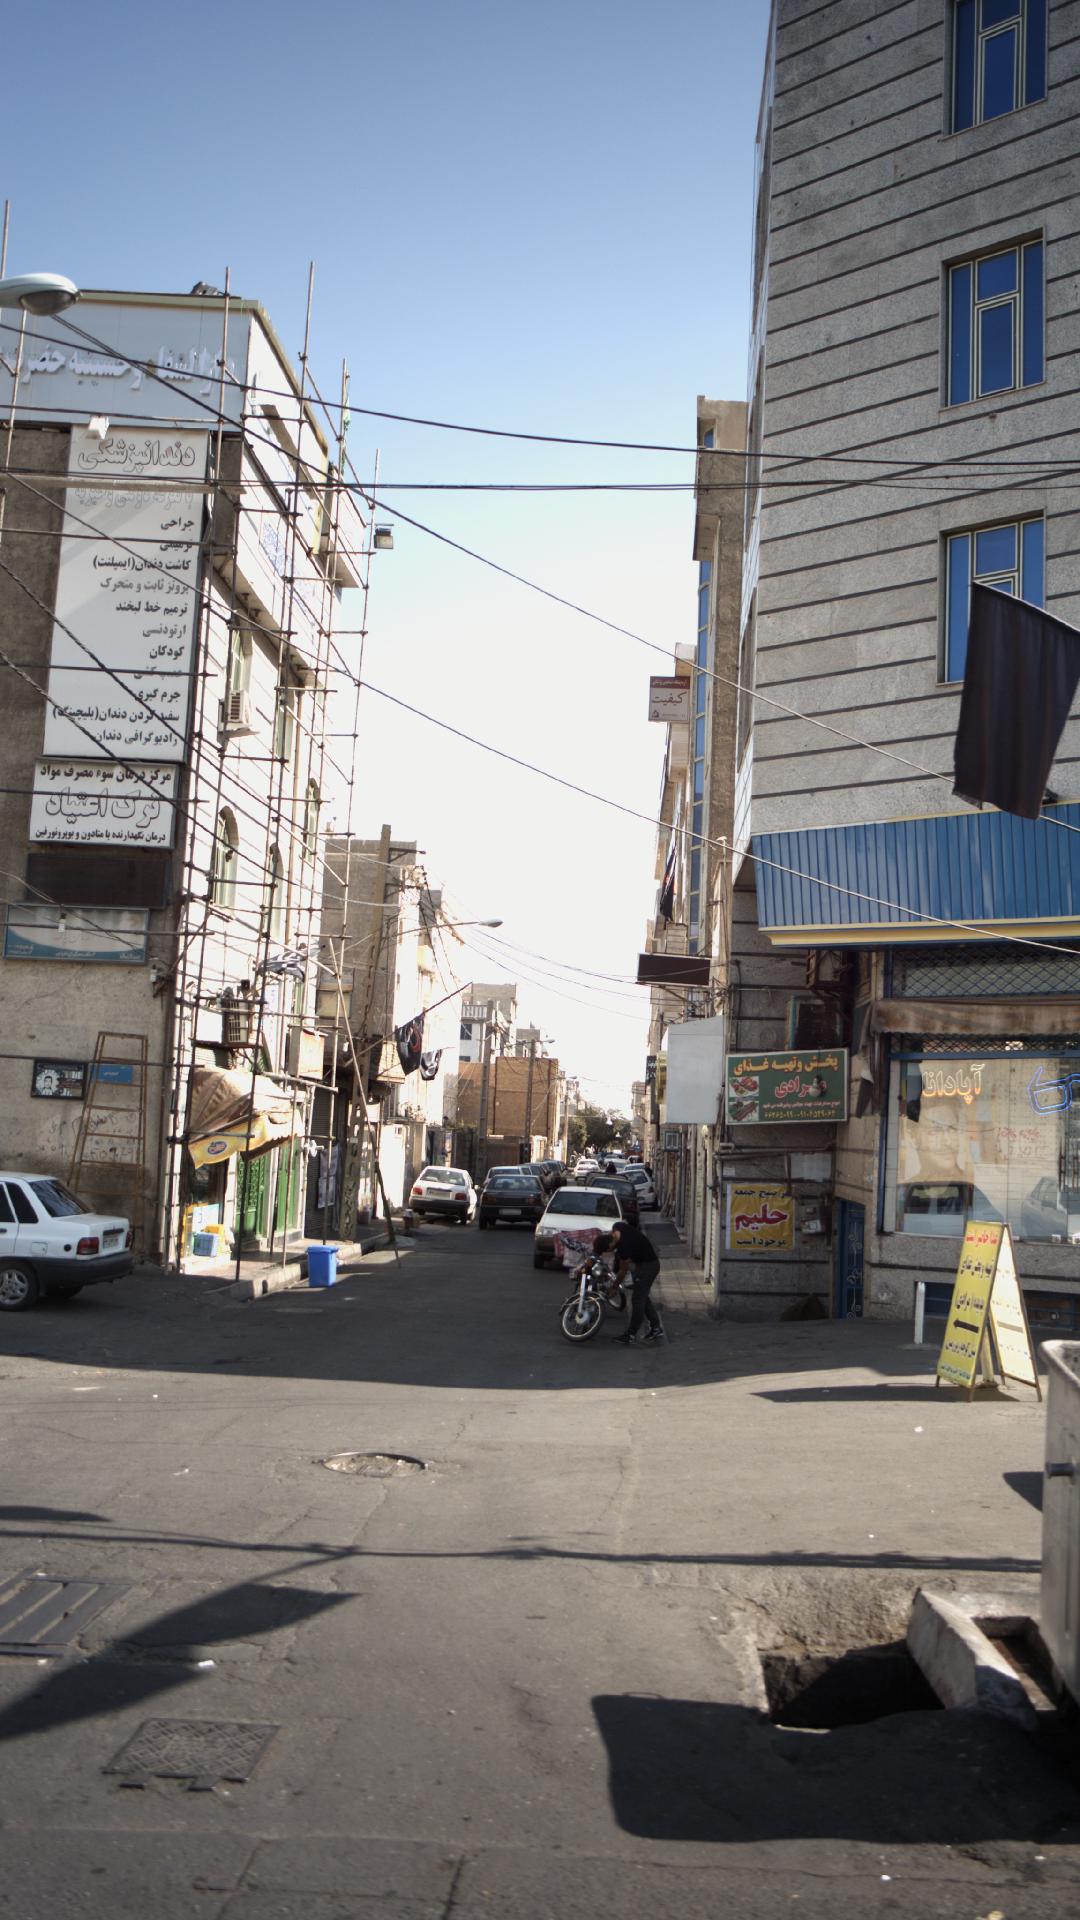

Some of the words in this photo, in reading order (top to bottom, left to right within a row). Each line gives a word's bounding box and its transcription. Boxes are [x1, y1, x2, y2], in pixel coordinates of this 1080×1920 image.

[78, 439, 196, 472] دندانپزشکی
[160, 516, 195, 532] جراحی
[165, 559, 192, 571] کاشت
[100, 577, 133, 593] متحرک
[115, 600, 142, 616] لبخند
[144, 600, 161, 612] خط
[163, 602, 188, 617] ترمیم
[142, 624, 187, 640] ارتودنسی
[149, 645, 185, 660] کودکان
[160, 690, 181, 704] جرم
[40, 765, 61, 781] مواد
[63, 765, 94, 782] مصرف
[96, 768, 114, 782] سوء
[149, 767, 172, 785] مرکز
[45, 786, 108, 825] اعتیاد
[111, 789, 162, 829] ترک
[733, 1056, 769, 1077] غذای
[804, 1054, 839, 1073] پخش
[734, 1188, 756, 1198] جمعه
[734, 1203, 789, 1232] حلیم
